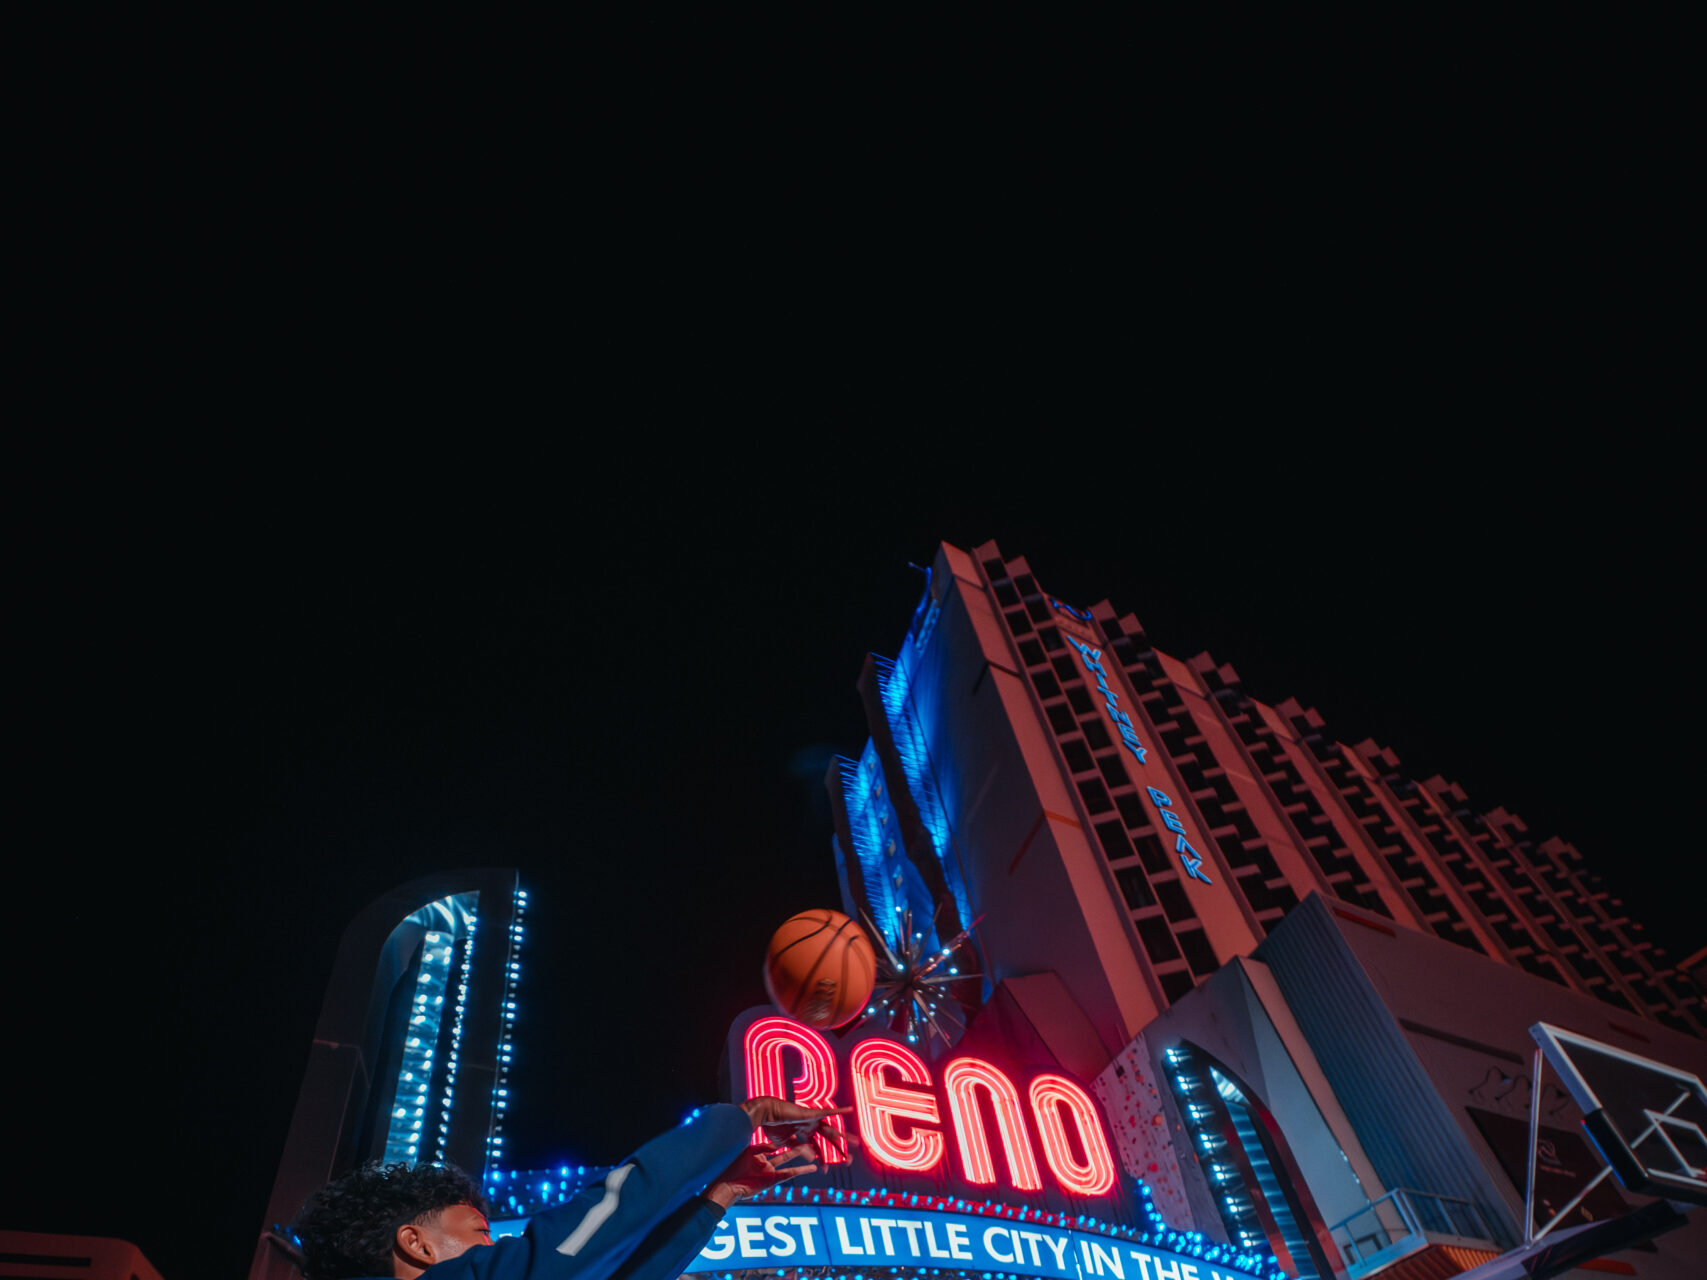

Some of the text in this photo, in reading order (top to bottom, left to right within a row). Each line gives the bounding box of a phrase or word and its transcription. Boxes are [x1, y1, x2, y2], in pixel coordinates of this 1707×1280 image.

[1067, 635, 1212, 885] WHITNEY PEAK
[700, 1216, 818, 1260] GEST
[835, 1215, 973, 1260] LITTLE
[983, 1226, 1068, 1270] CITY
[1080, 1240, 1125, 1280] IN
